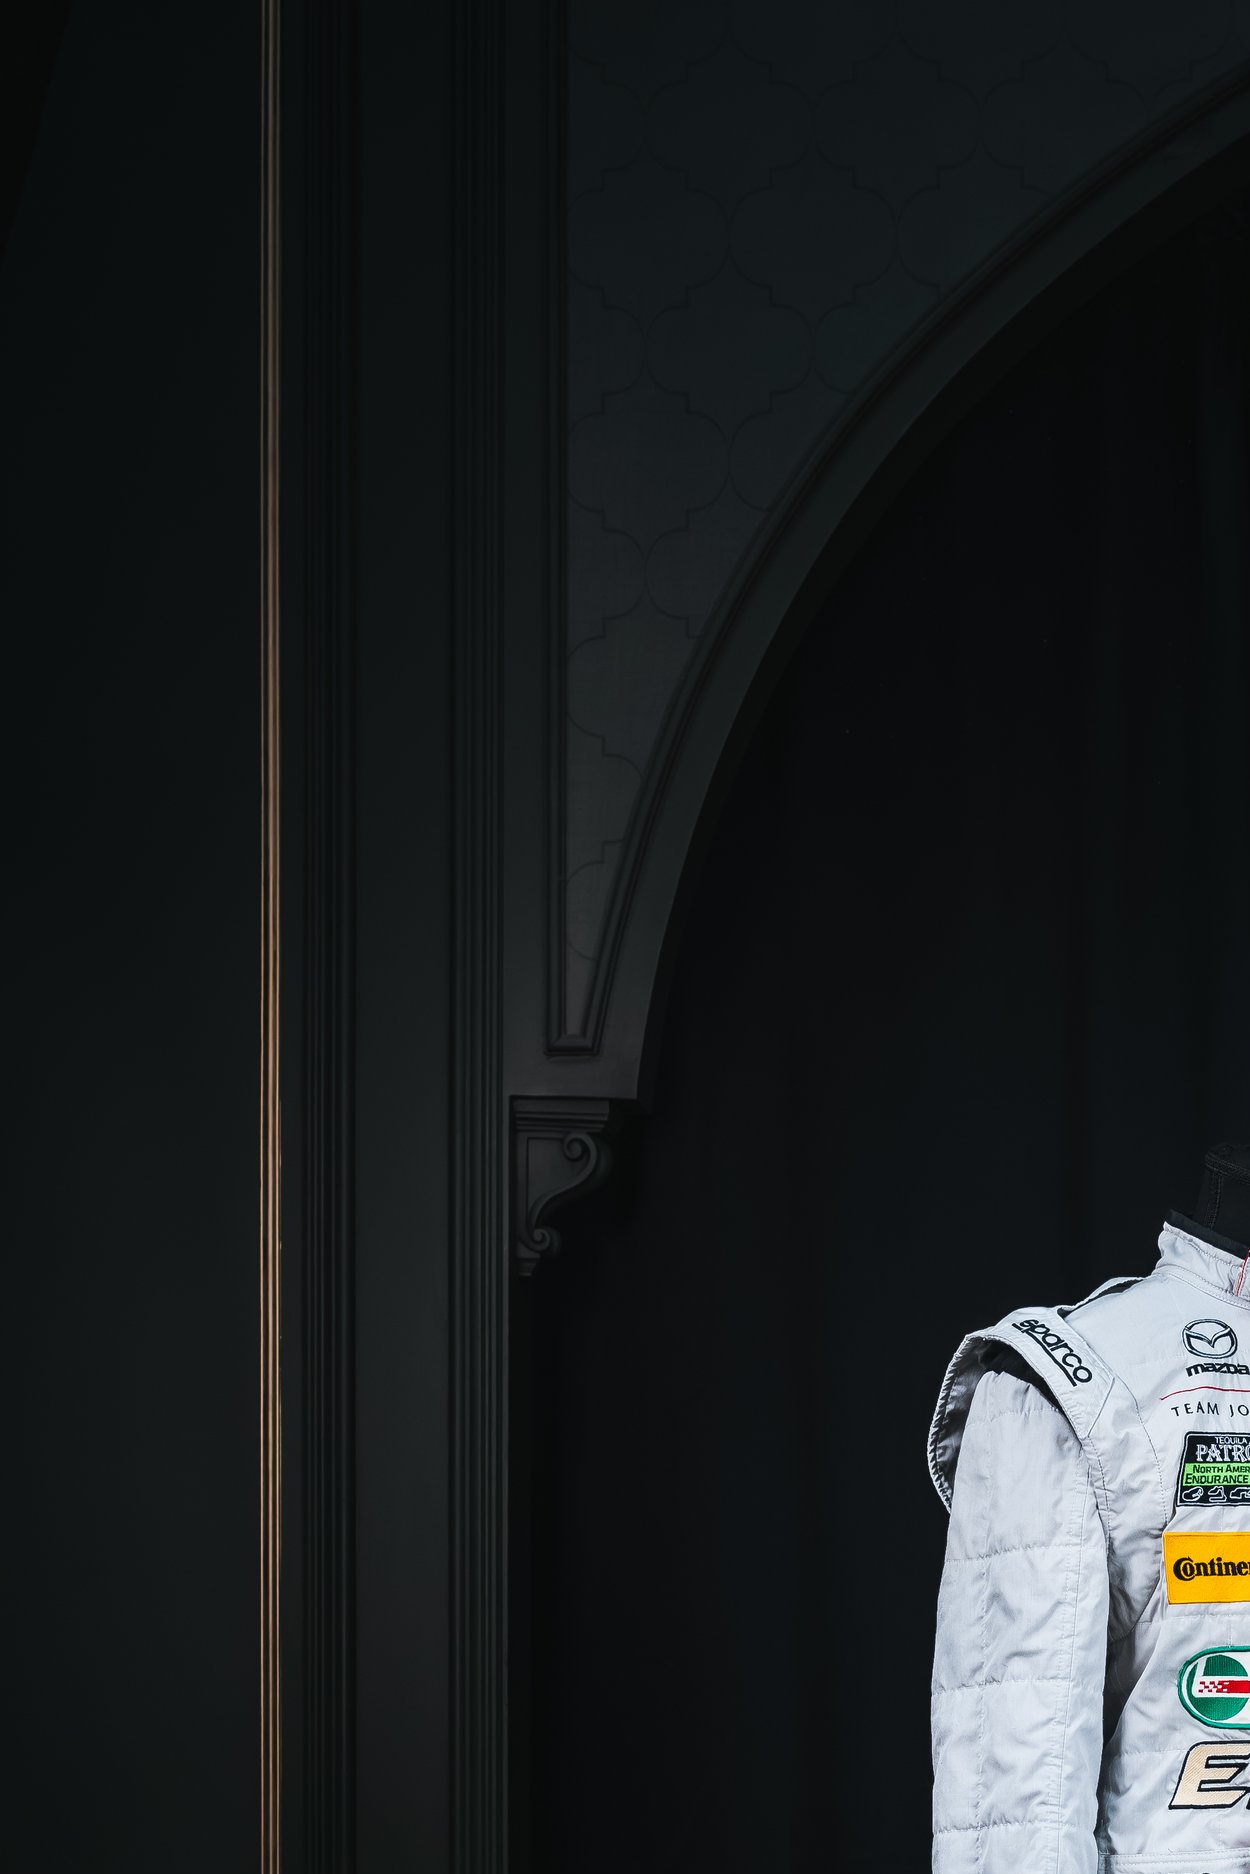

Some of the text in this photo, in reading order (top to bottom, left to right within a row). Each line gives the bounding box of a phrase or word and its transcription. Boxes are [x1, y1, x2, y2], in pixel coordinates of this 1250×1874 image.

[1019, 1319, 1093, 1384] sparco
[1185, 1362, 1250, 1377] mazda
[1170, 1401, 1220, 1417] TEAM
[1214, 1436, 1248, 1445] TEQUILA
[1192, 1464, 1224, 1474] NORTH
[1184, 1473, 1249, 1485] ENDURANCE
